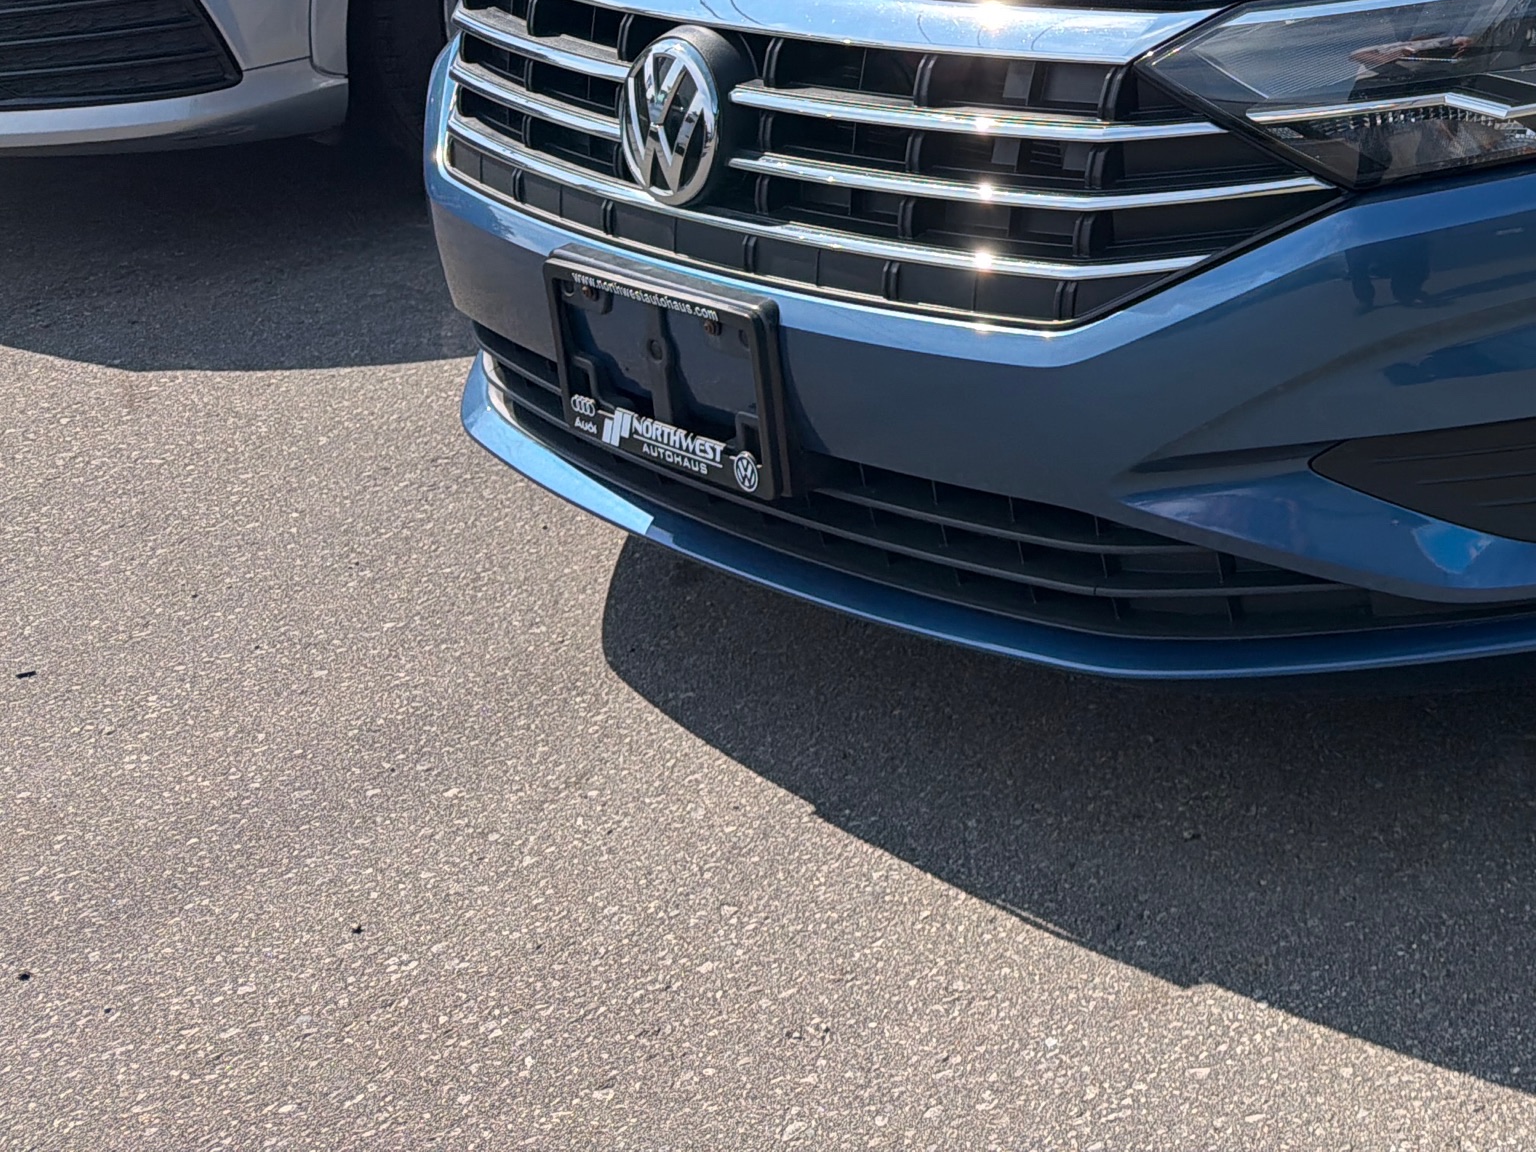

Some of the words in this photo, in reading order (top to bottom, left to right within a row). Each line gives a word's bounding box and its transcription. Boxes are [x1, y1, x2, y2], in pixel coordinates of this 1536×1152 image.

[571, 271, 719, 322] www.northwestautohaus.com
[574, 416, 598, 435] Audi
[631, 413, 727, 464] NORTHWEST
[641, 442, 709, 475] AUTOHAUS
